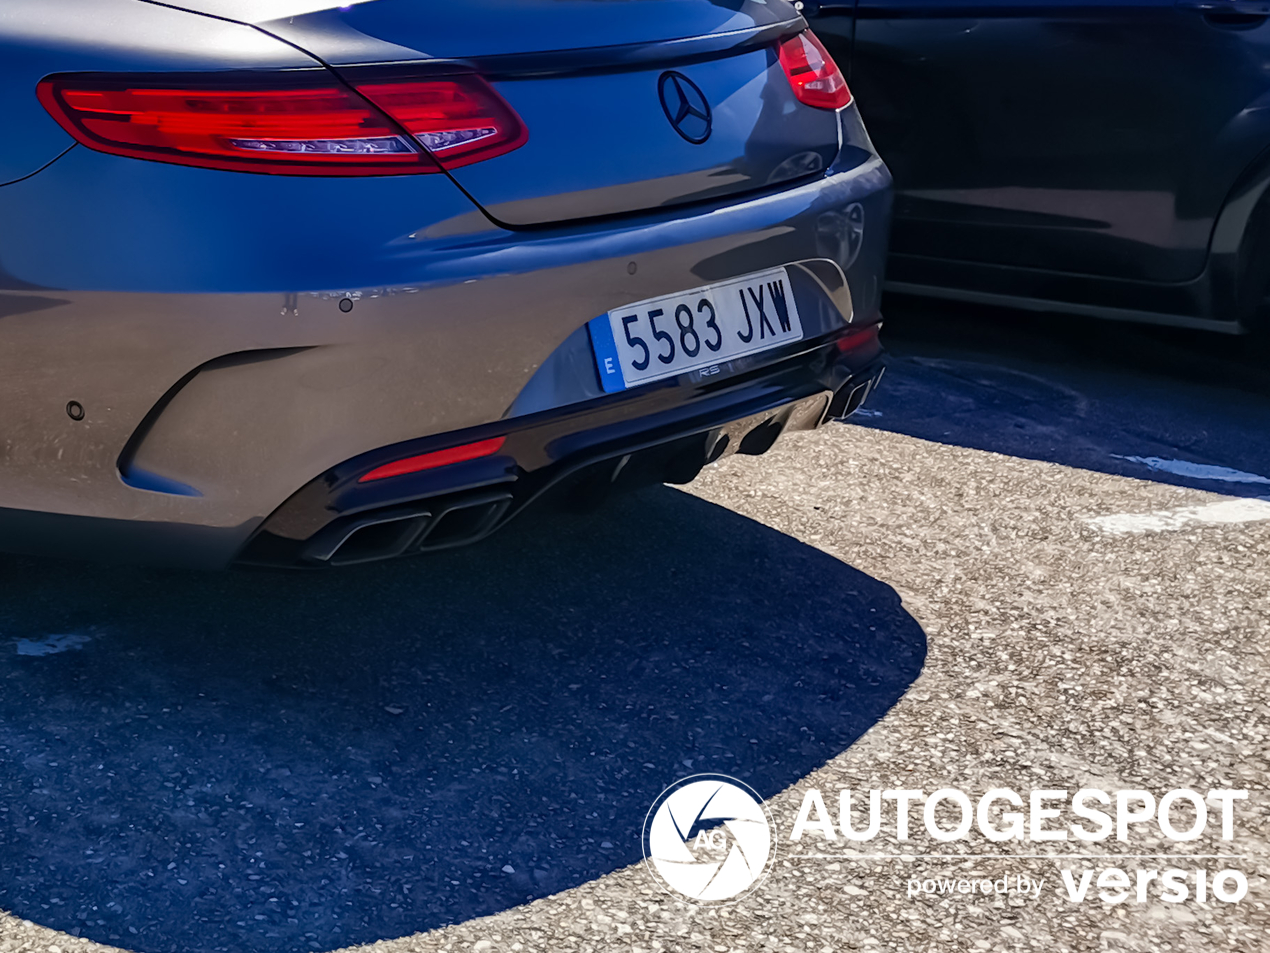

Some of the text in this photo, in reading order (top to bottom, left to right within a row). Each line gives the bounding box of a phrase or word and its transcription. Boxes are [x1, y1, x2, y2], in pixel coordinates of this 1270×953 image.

[622, 279, 791, 371] 5583 JXW
[604, 357, 615, 374] E
